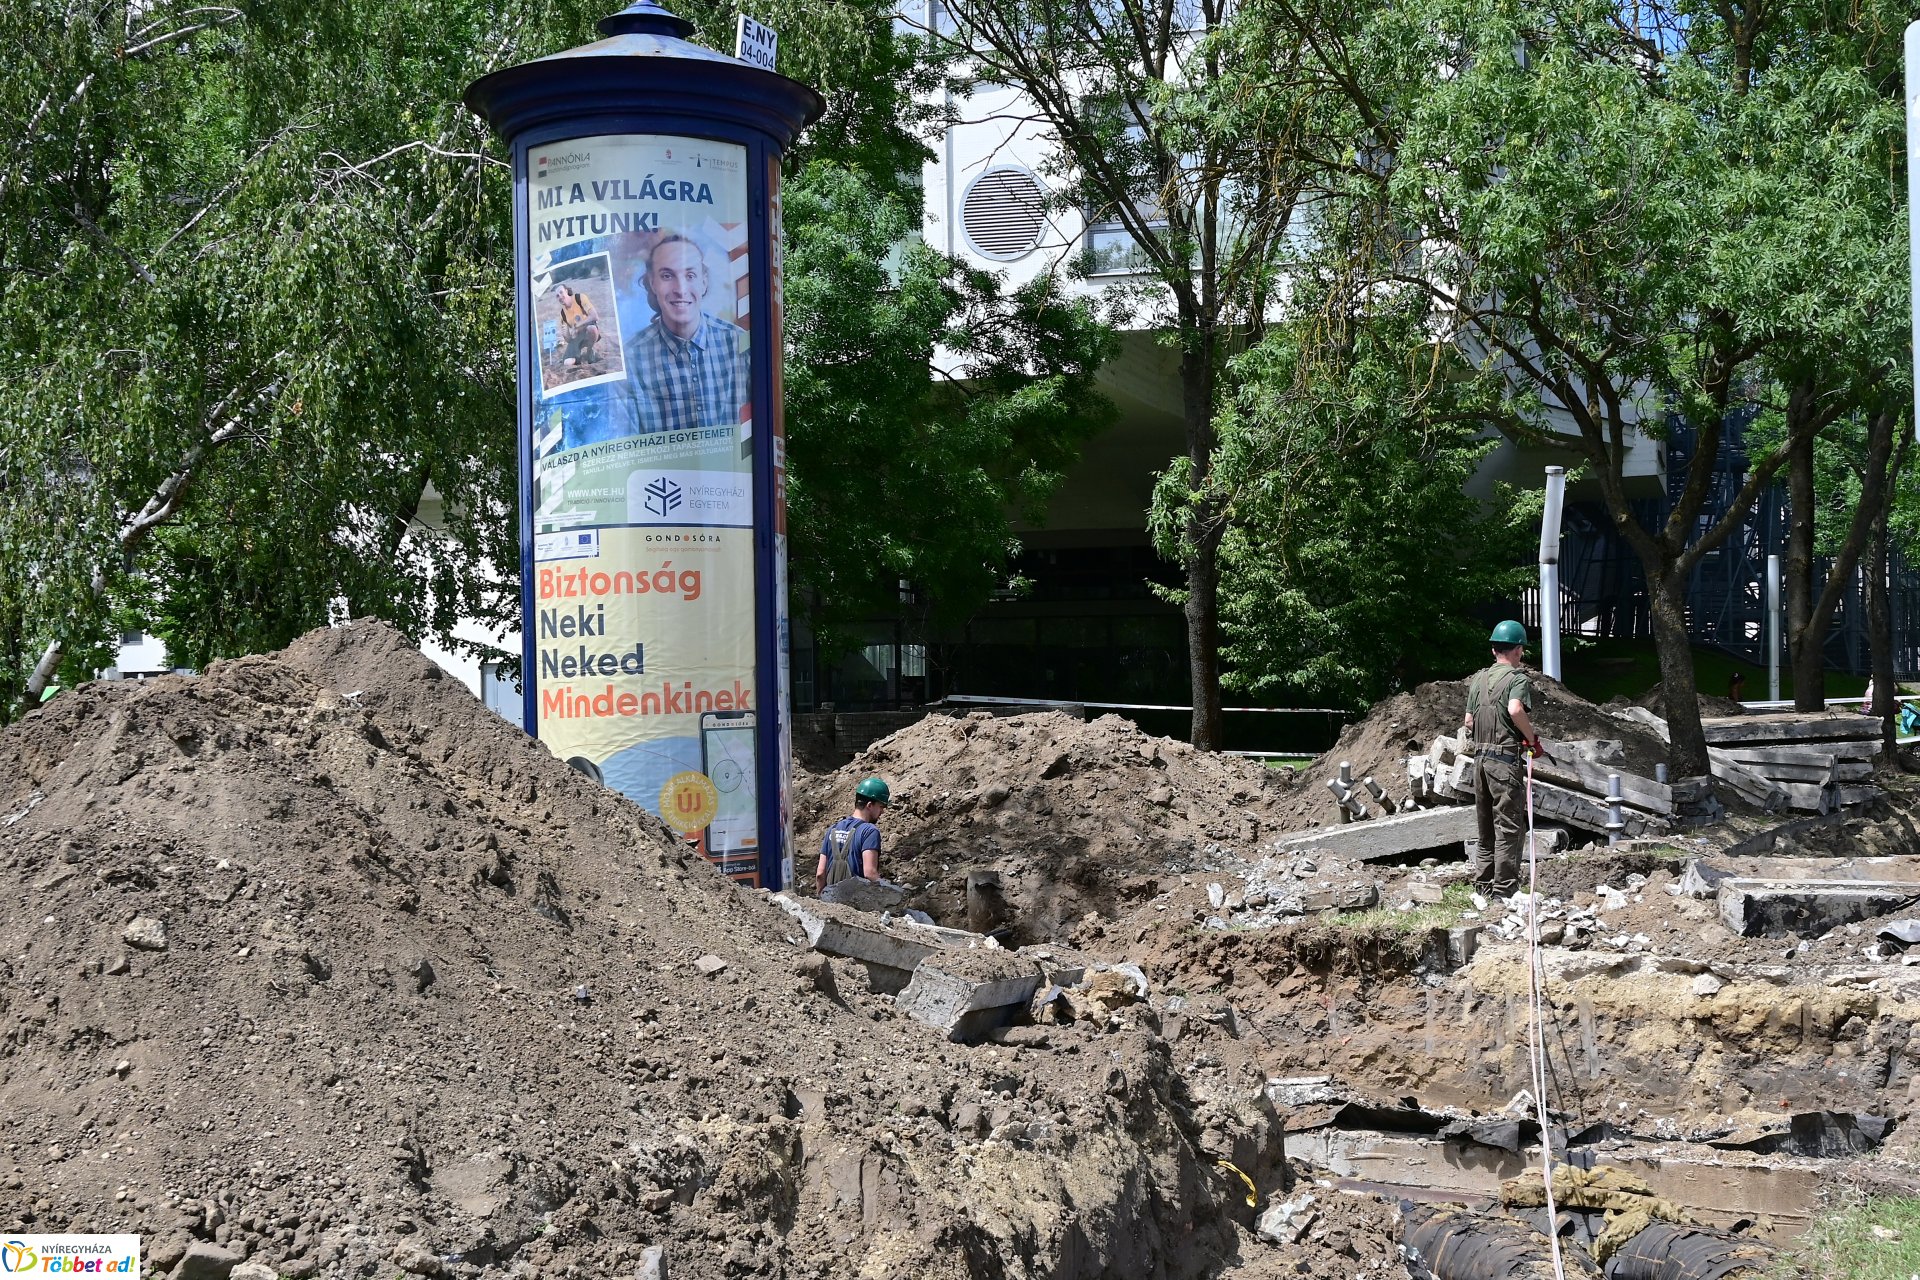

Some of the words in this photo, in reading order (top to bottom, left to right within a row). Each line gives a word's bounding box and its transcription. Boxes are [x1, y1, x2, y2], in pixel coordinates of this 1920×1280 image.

[744, 18, 775, 49] E.NY
[741, 41, 774, 71] 04-004
[712, 159, 738, 168] TEMPUS
[538, 185, 563, 210] MI
[569, 182, 585, 204] A
[591, 173, 714, 205] VILÁGRA
[538, 212, 659, 243] NYITUNK!
[542, 452, 580, 472] VÁLASZD
[581, 450, 589, 460] A
[591, 435, 666, 457] NYÍREGYHÁZI
[669, 427, 734, 444] EGYETEMET!
[567, 487, 625, 498] WWW.NYE.HU
[689, 485, 745, 497] NYÍREGYHÁZI
[689, 500, 729, 509] EGYETEM
[539, 560, 701, 600] Biztonság
[541, 603, 605, 639] Neki
[541, 643, 644, 679] Neked
[542, 680, 751, 719] Mindenkinek
[677, 787, 702, 814] ÚJ
